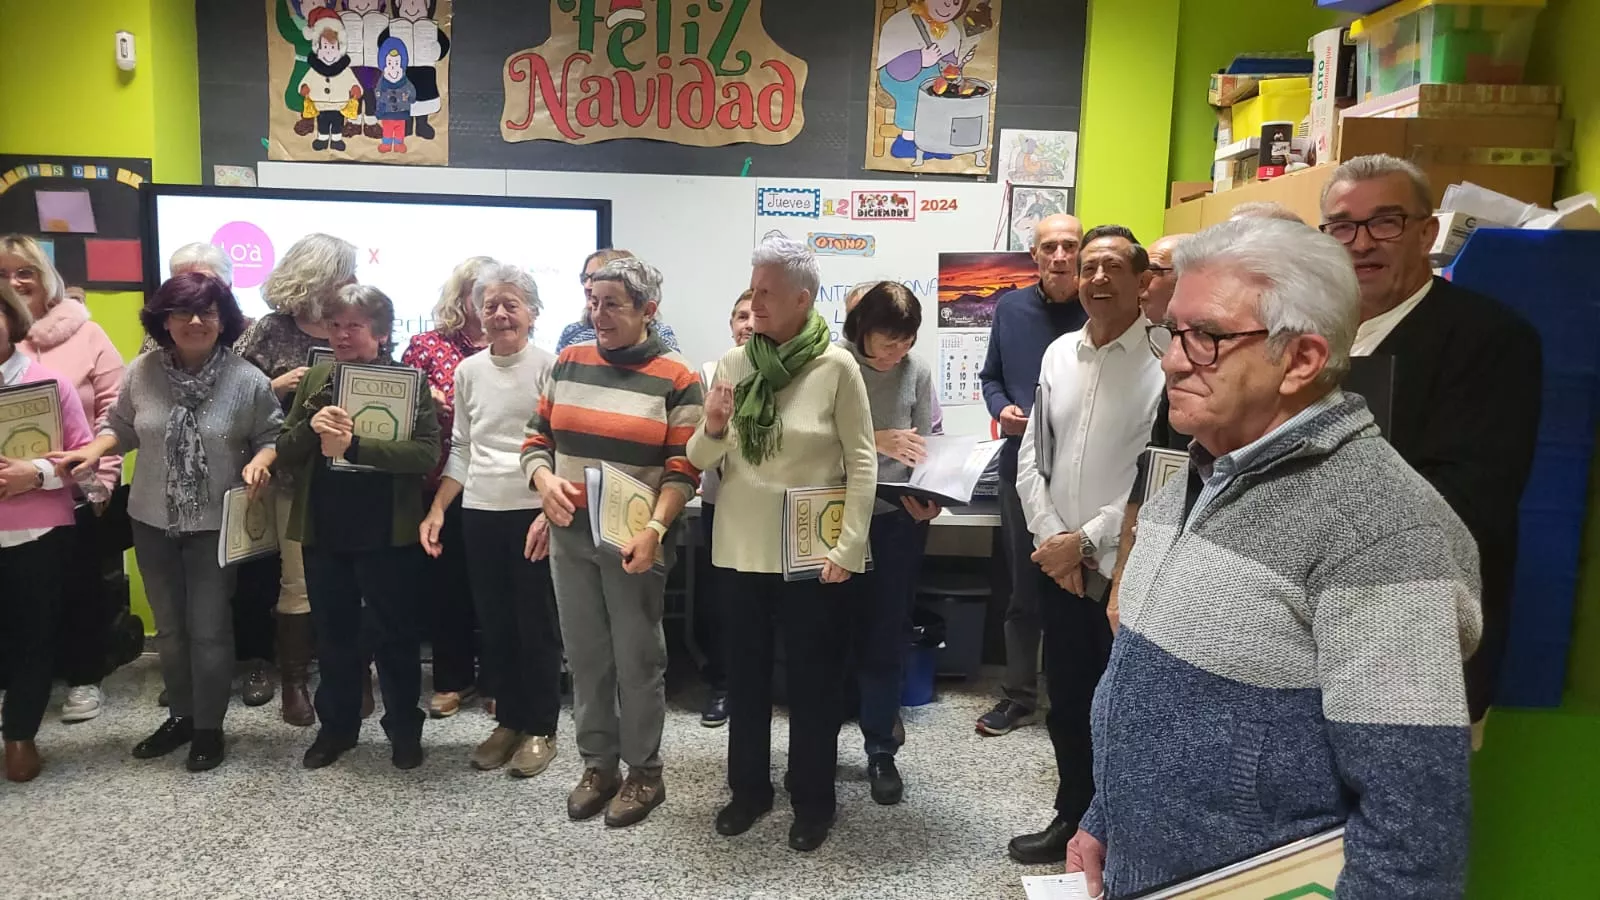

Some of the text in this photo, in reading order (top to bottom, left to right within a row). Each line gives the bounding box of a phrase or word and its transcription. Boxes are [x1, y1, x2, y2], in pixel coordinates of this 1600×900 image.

[1317, 60, 1325, 101] LOTO
[505, 52, 797, 140] Navidad
[767, 193, 959, 218] Jueves 12 DICIEMBRE 2024
[946, 362, 951, 371] 2
[946, 372, 951, 381] 9
[959, 372, 967, 381] 10
[354, 380, 403, 396] CORO
[945, 382, 952, 391] 16
[959, 382, 966, 391] 17
[799, 502, 809, 554] CORO
